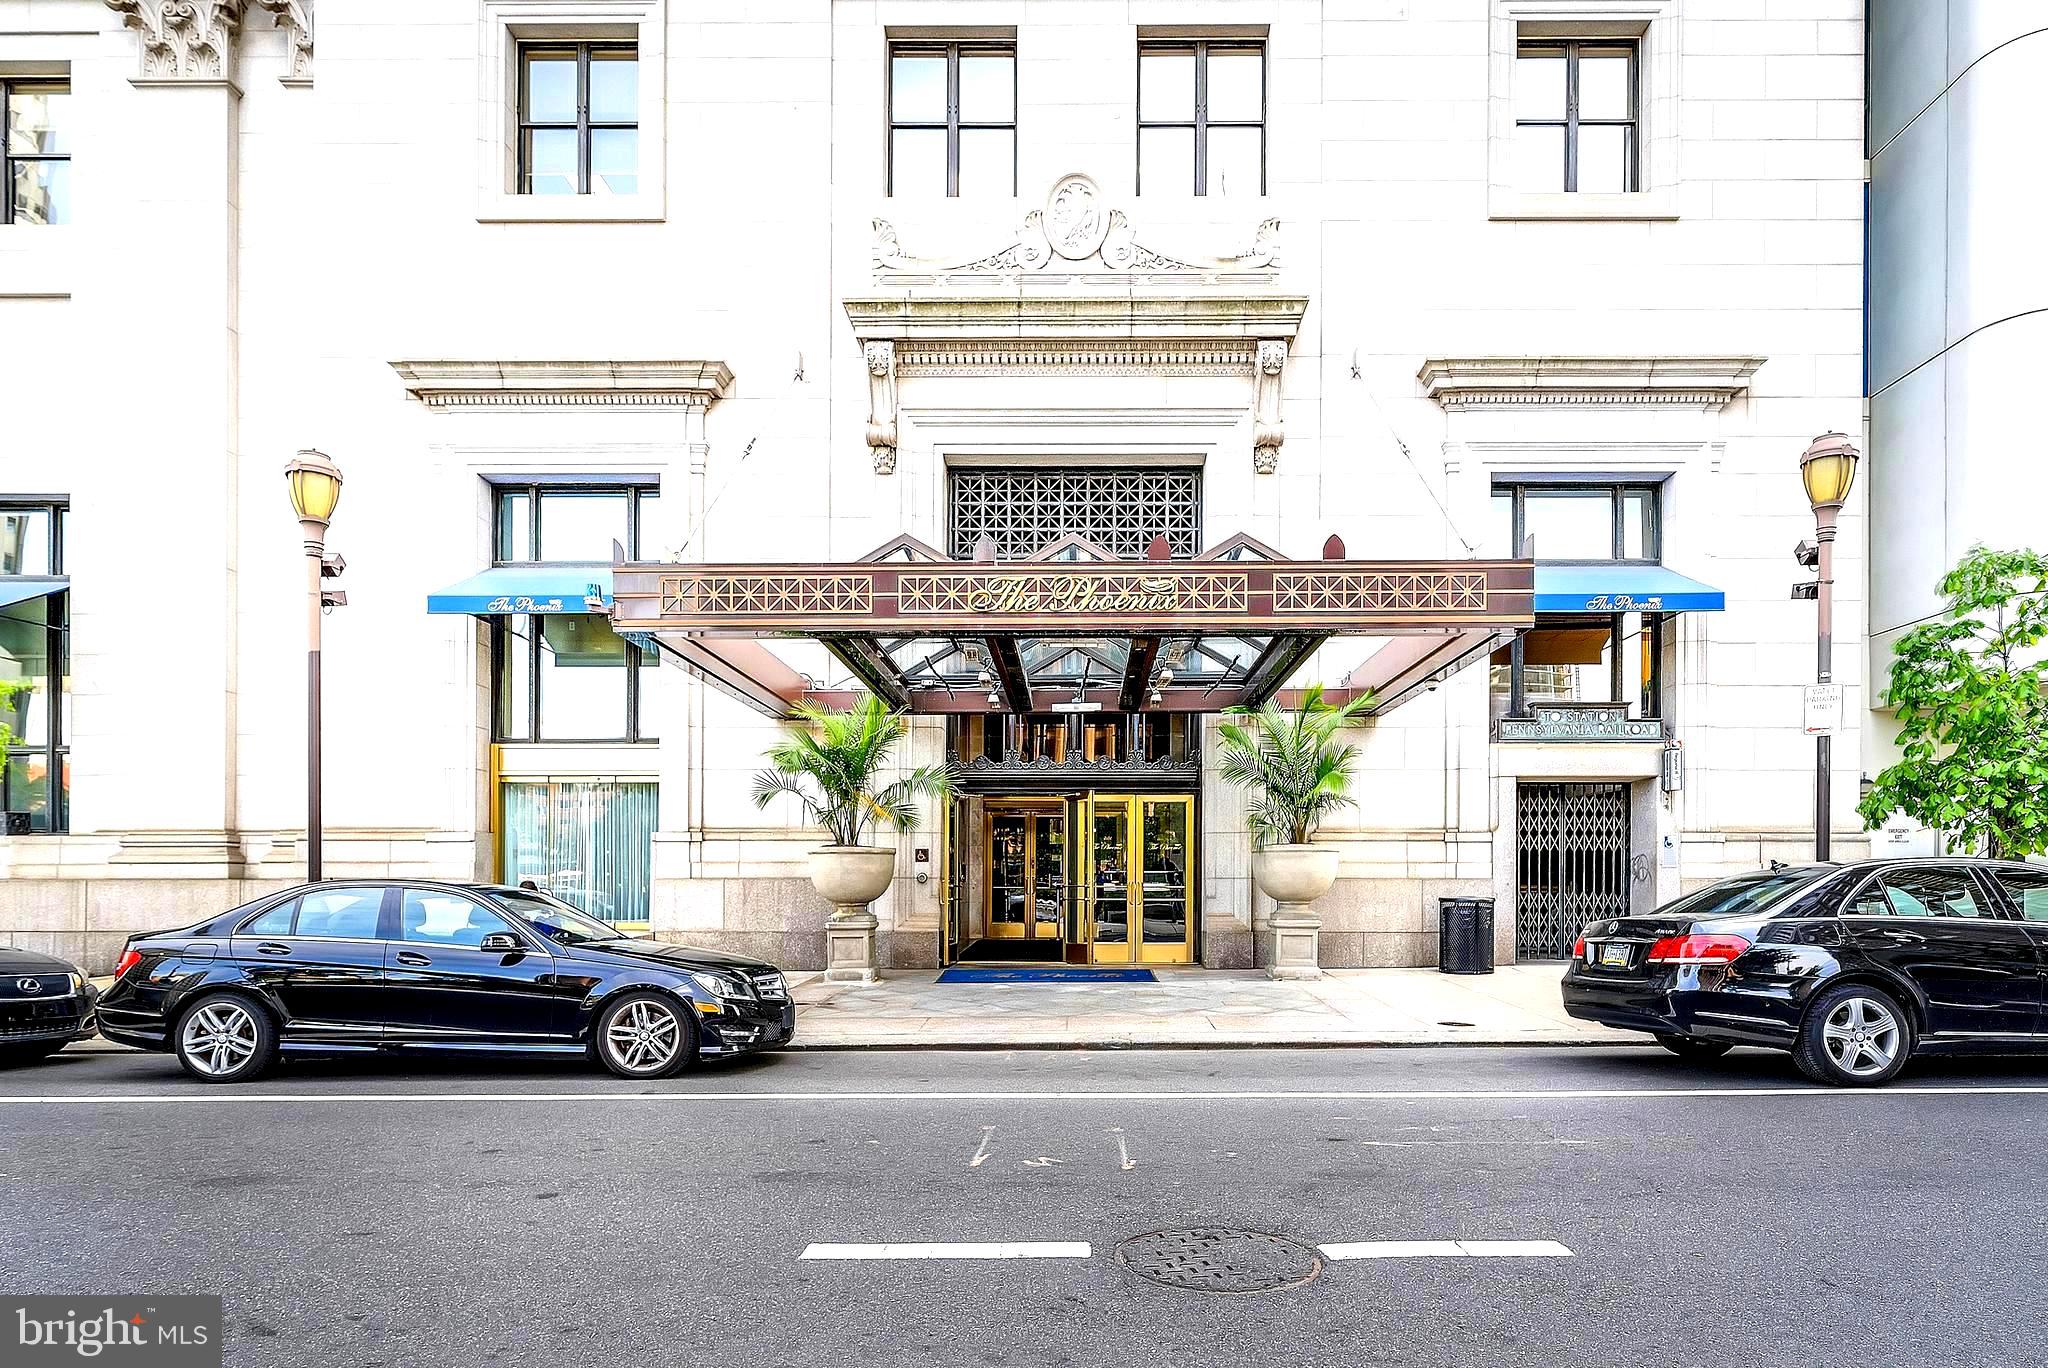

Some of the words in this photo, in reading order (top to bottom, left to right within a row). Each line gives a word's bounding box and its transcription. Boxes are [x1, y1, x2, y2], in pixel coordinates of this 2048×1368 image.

[970, 577, 1039, 612] The
[1050, 575, 1178, 612] Phoenix
[488, 596, 514, 612] The
[515, 596, 564, 612] Phoenix
[1585, 595, 1613, 610] The
[1614, 595, 1664, 610] Phoenix
[1544, 711, 1561, 722] TO
[1567, 711, 1616, 722] STATION
[1504, 724, 1593, 736] PENNSYLVANIA
[1598, 724, 1657, 736] RAILROAD
